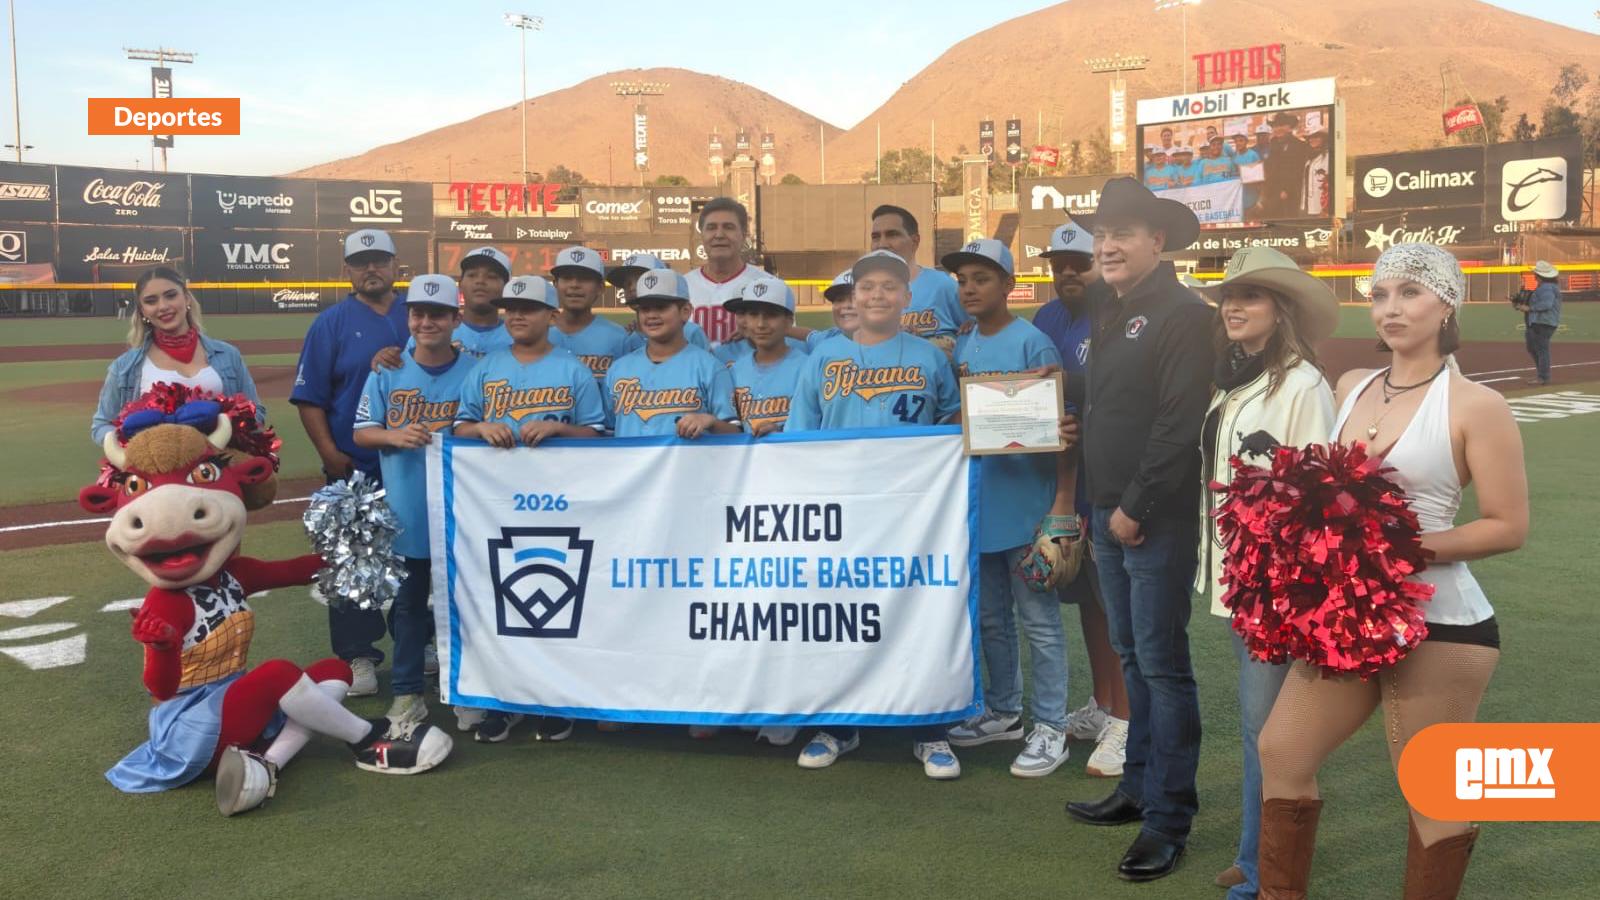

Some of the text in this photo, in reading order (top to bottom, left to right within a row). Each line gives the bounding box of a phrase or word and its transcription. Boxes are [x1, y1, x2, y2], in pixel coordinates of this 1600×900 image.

[1192, 43, 1283, 88] TOROS
[1172, 88, 1290, 118] Mobil Park
[83, 178, 165, 207] Coca-Cola
[1395, 171, 1476, 190] Calimax
[238, 193, 294, 209] aprecio
[350, 189, 402, 216] abc
[448, 182, 561, 212] TECATE
[586, 200, 644, 214] Comex
[1065, 190, 1101, 209] rub
[1183, 200, 1211, 212] EXICO
[450, 221, 488, 231] Forever
[464, 231, 493, 239] Pizza
[528, 229, 570, 240] Totalplay
[1389, 228, 1433, 246] Carl's
[83, 246, 169, 263] Salsa Huichol
[222, 243, 290, 264] VMC
[1203, 239, 1220, 249] de
[1223, 239, 1241, 249] los
[824, 358, 921, 401] Tijuana
[387, 388, 460, 428] Tijua
[484, 379, 571, 421] Tijuana
[614, 377, 698, 416] Tijuana
[892, 394, 926, 423] 47
[513, 493, 568, 511] 2026
[726, 503, 842, 542] MEXICO
[611, 554, 958, 588] LITTLE LEAGUE BASEBALL
[688, 602, 881, 643] CHAMPIONS
